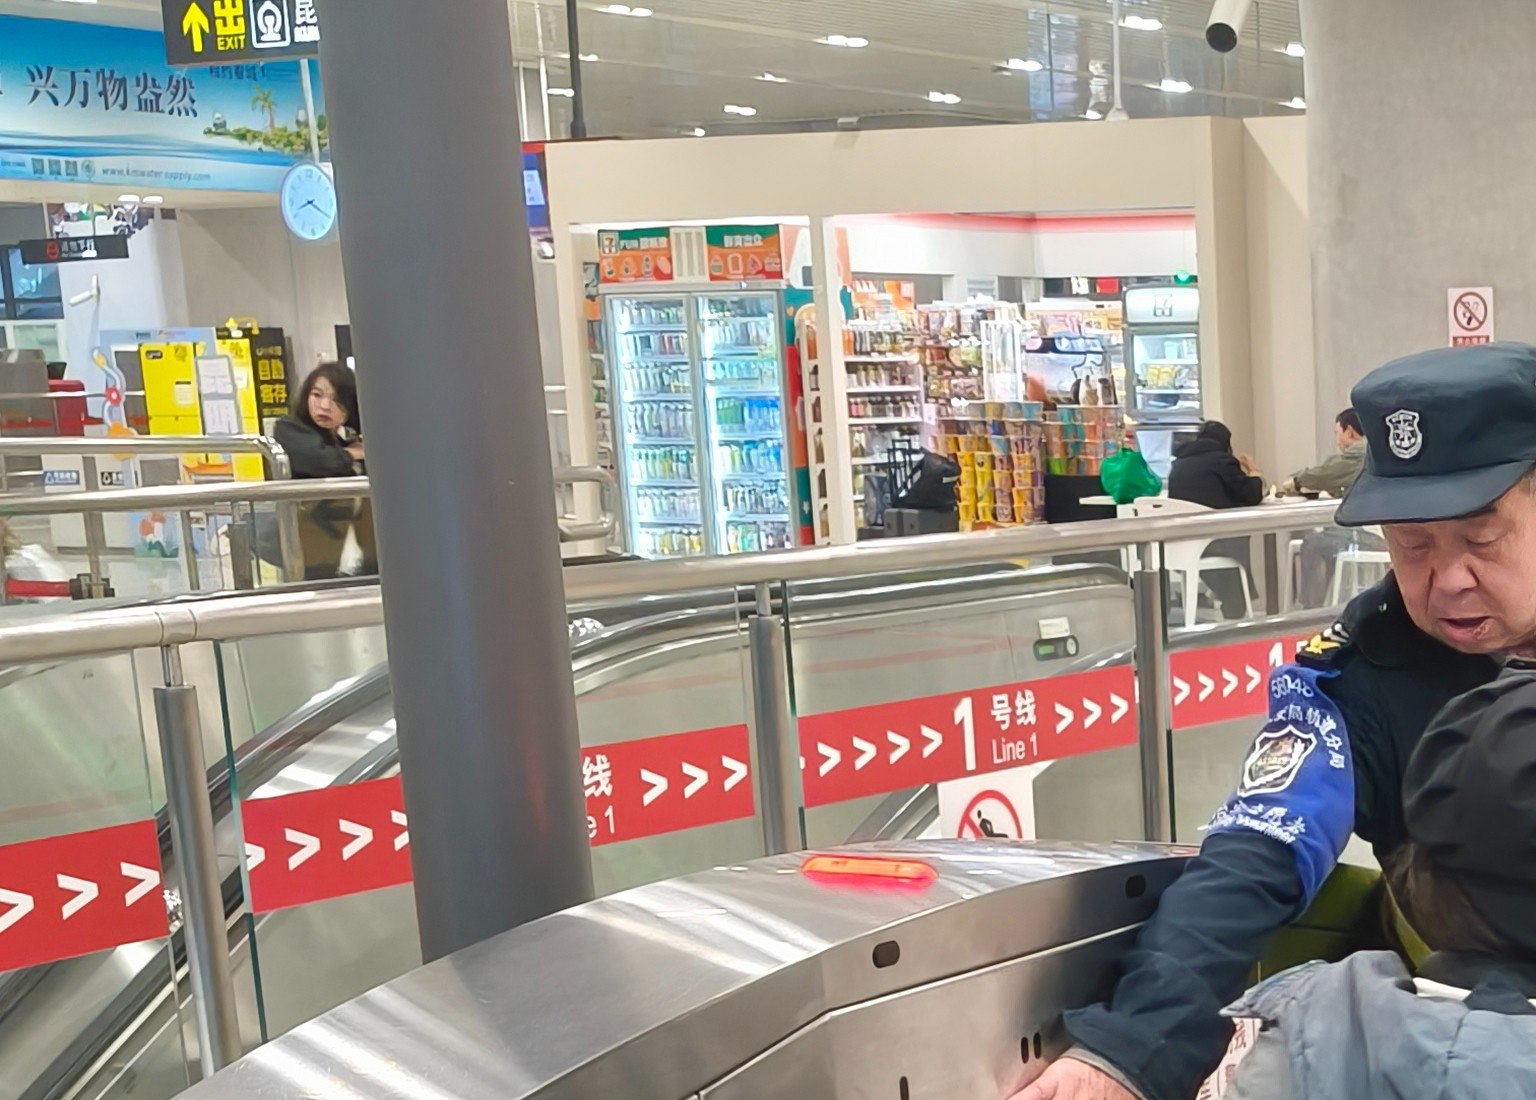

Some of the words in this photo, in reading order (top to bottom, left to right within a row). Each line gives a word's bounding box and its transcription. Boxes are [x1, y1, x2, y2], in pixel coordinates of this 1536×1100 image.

[217, 36, 245, 50] EXIT
[953, 696, 977, 771] 1
[990, 689, 1037, 731] 号线
[991, 737, 1026, 764] Line
[1029, 732, 1038, 757] 1
[582, 754, 613, 798] 线
[604, 805, 615, 835] 1
